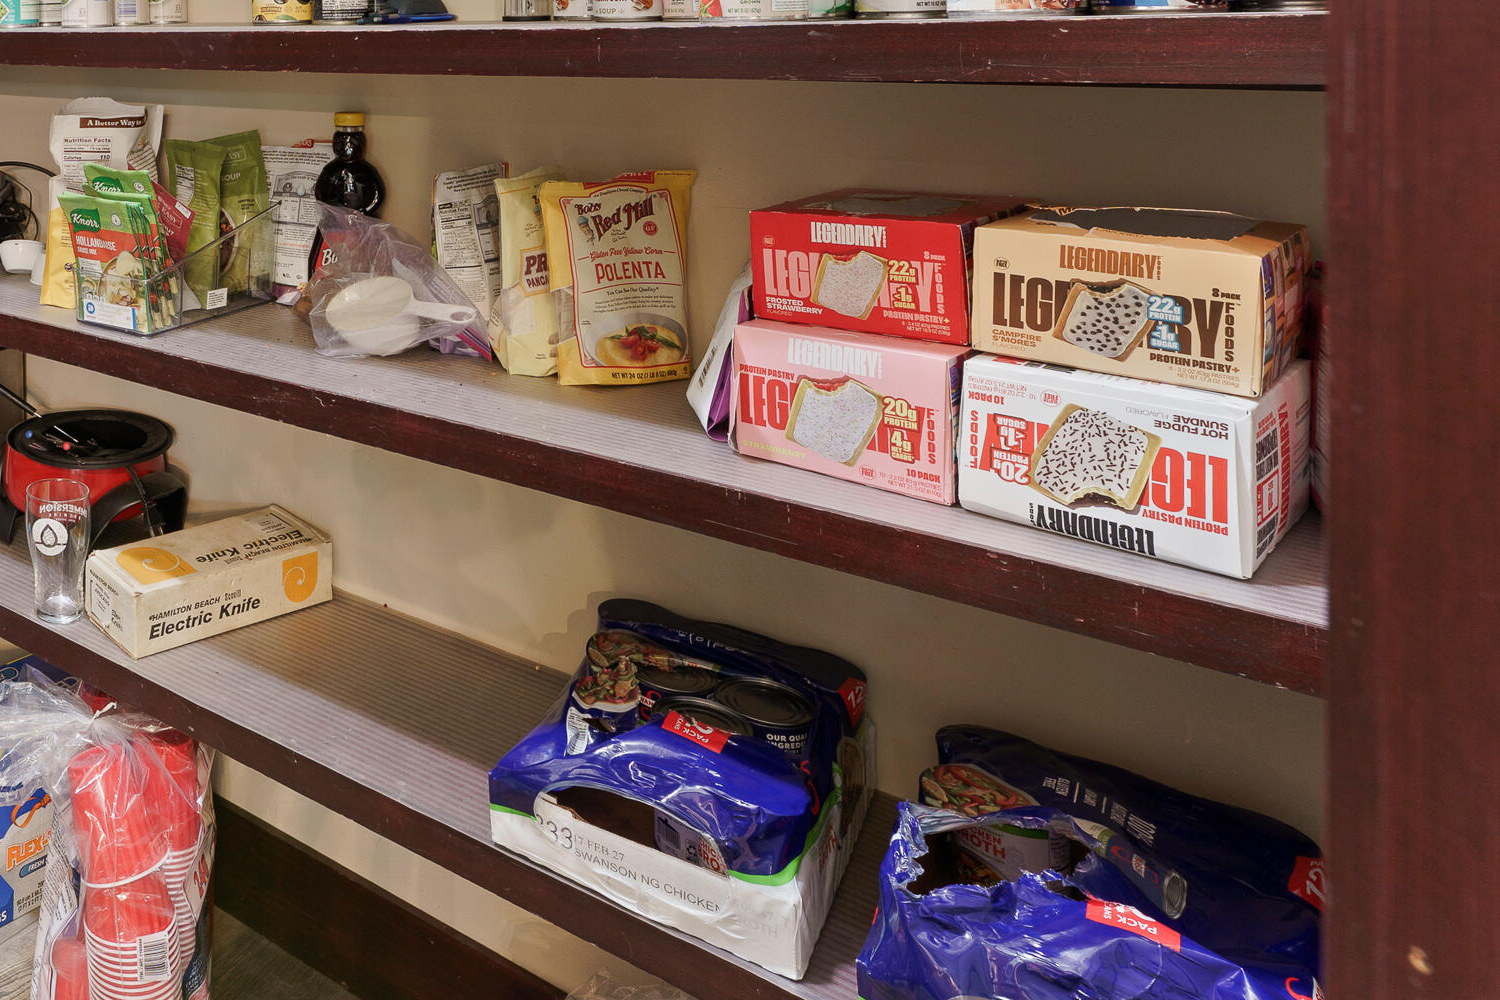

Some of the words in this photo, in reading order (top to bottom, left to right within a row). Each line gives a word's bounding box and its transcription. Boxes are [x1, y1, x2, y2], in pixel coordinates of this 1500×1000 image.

[71, 212, 100, 228] Knorr
[574, 201, 602, 216] Bob's
[590, 203, 623, 242] Red
[621, 194, 656, 231] Mill
[75, 234, 117, 251] HOLLANDAISE
[810, 220, 882, 248] LEGENDARY
[889, 260, 916, 277] 22g
[1059, 244, 1157, 280] LEGENDARY
[595, 260, 667, 285] POLENTA
[889, 274, 916, 284] PROTEIN
[766, 296, 804, 306] FROSTED
[766, 302, 823, 316] STRAWBERRY
[894, 300, 916, 310] SUGAR
[992, 328, 1042, 343] CAMPFIRE
[992, 334, 1037, 348] S'MORES
[787, 336, 880, 379] LEGENDARY
[739, 363, 767, 376] PROTEIN
[767, 368, 795, 382] PASTRY
[884, 396, 918, 421] 20g
[1154, 419, 1206, 437] FUDGE
[1209, 428, 1229, 440] HOT
[741, 439, 806, 459] STRAWBERRY
[906, 467, 916, 477] 10
[917, 469, 941, 484] PACK
[242, 529, 304, 550] Electric
[1035, 504, 1157, 557] LEGENDARY
[195, 547, 240, 565] Knife
[149, 605, 193, 622] HAMILTON
[194, 596, 220, 610] BEACH
[148, 612, 212, 641] Electric
[219, 596, 261, 620] Knife
[682, 725, 710, 745] PACK
[766, 733, 786, 743] OUR
[27, 856, 46, 873] FRESH
[573, 849, 637, 882] SWANSON
[640, 873, 661, 890] NG
[1116, 915, 1158, 936] PACK
